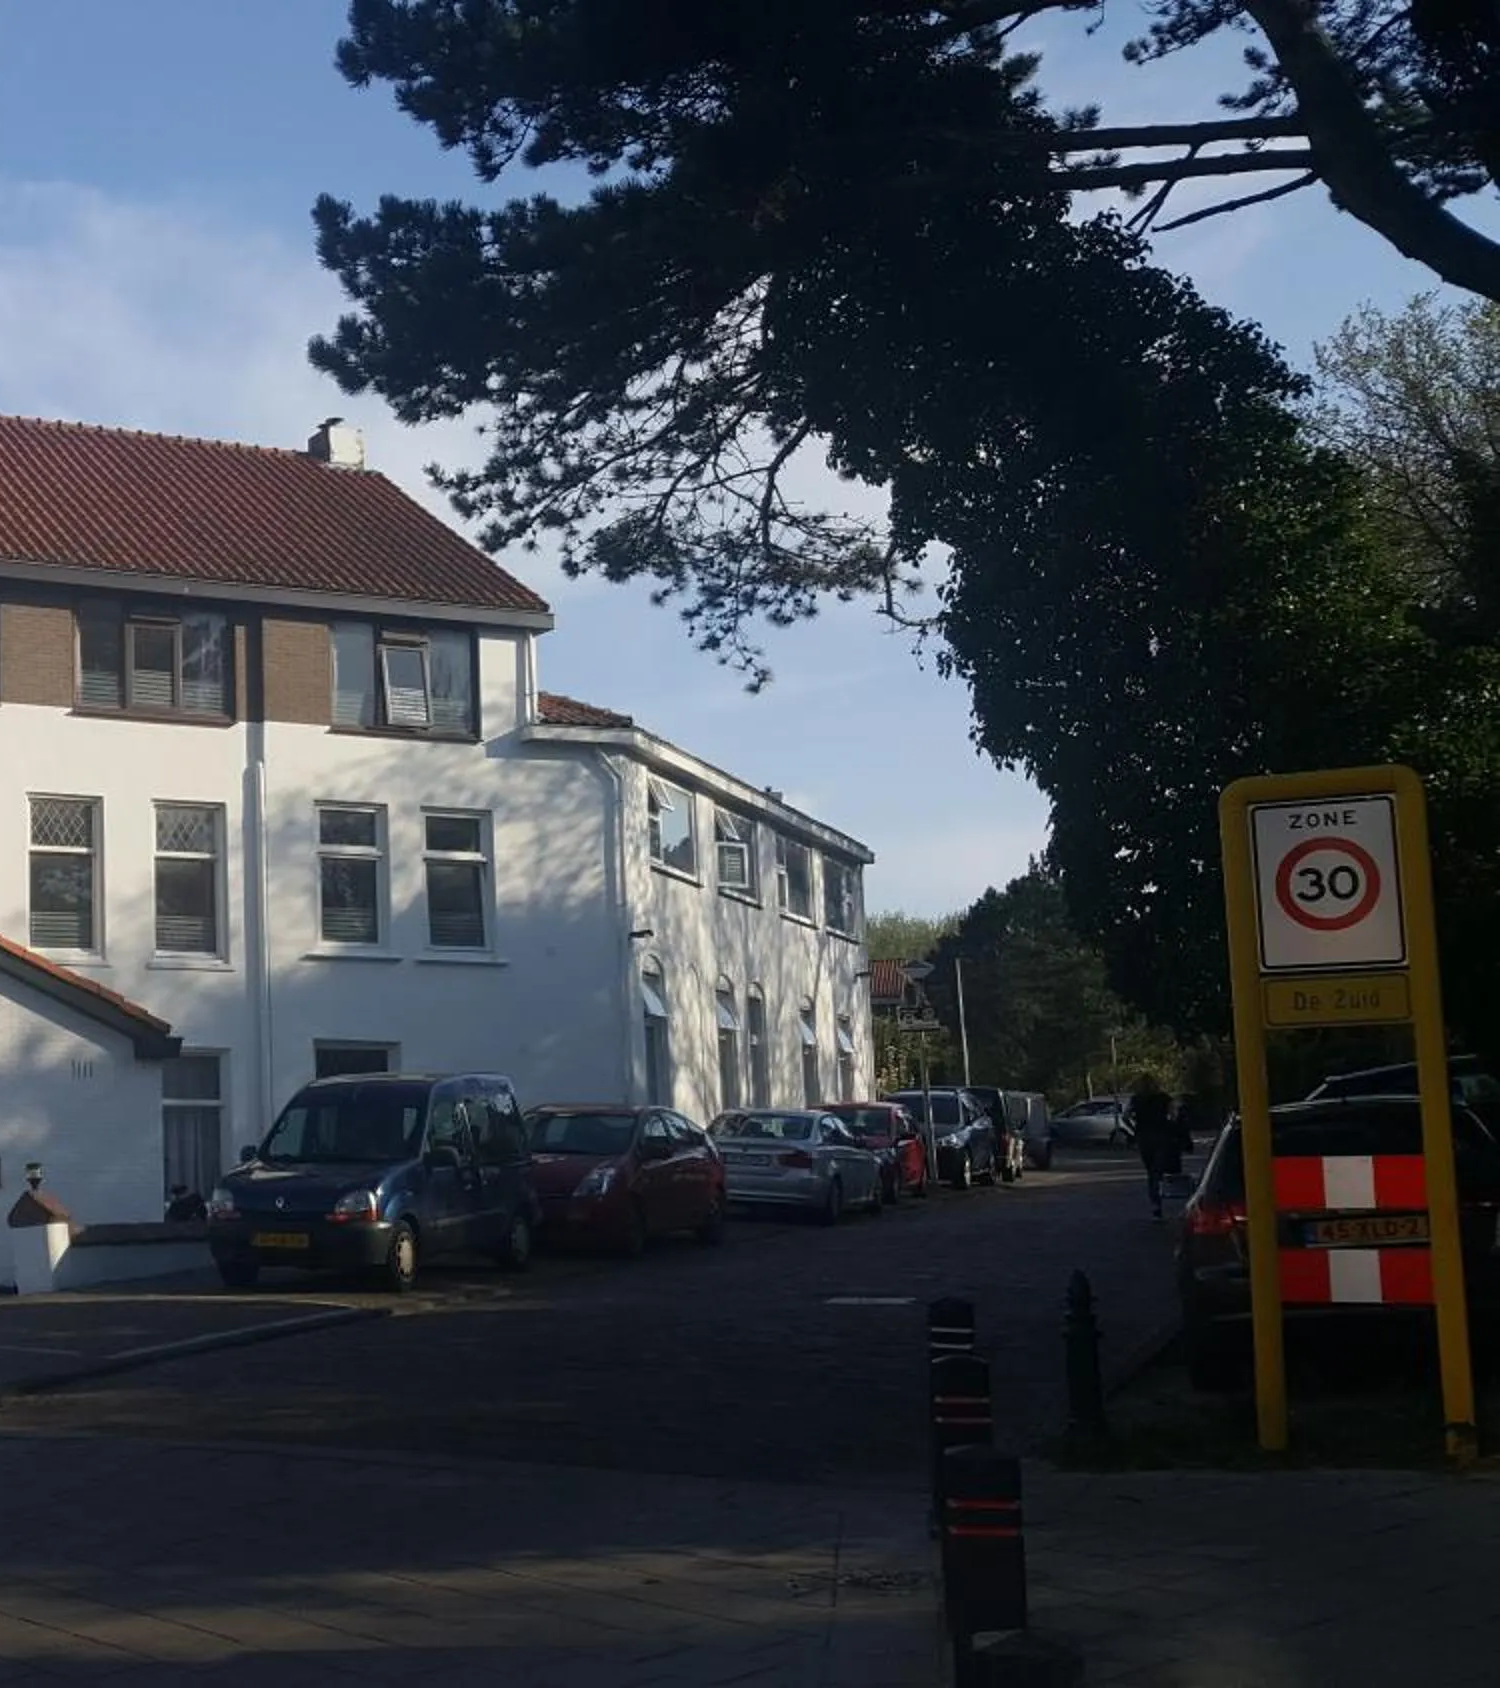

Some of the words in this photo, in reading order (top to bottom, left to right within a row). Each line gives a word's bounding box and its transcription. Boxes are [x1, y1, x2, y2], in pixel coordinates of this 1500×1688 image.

[1288, 809, 1357, 829] ZONE
[1296, 865, 1359, 902] 30
[1293, 991, 1320, 1011] De
[1334, 988, 1381, 1009] Zuid
